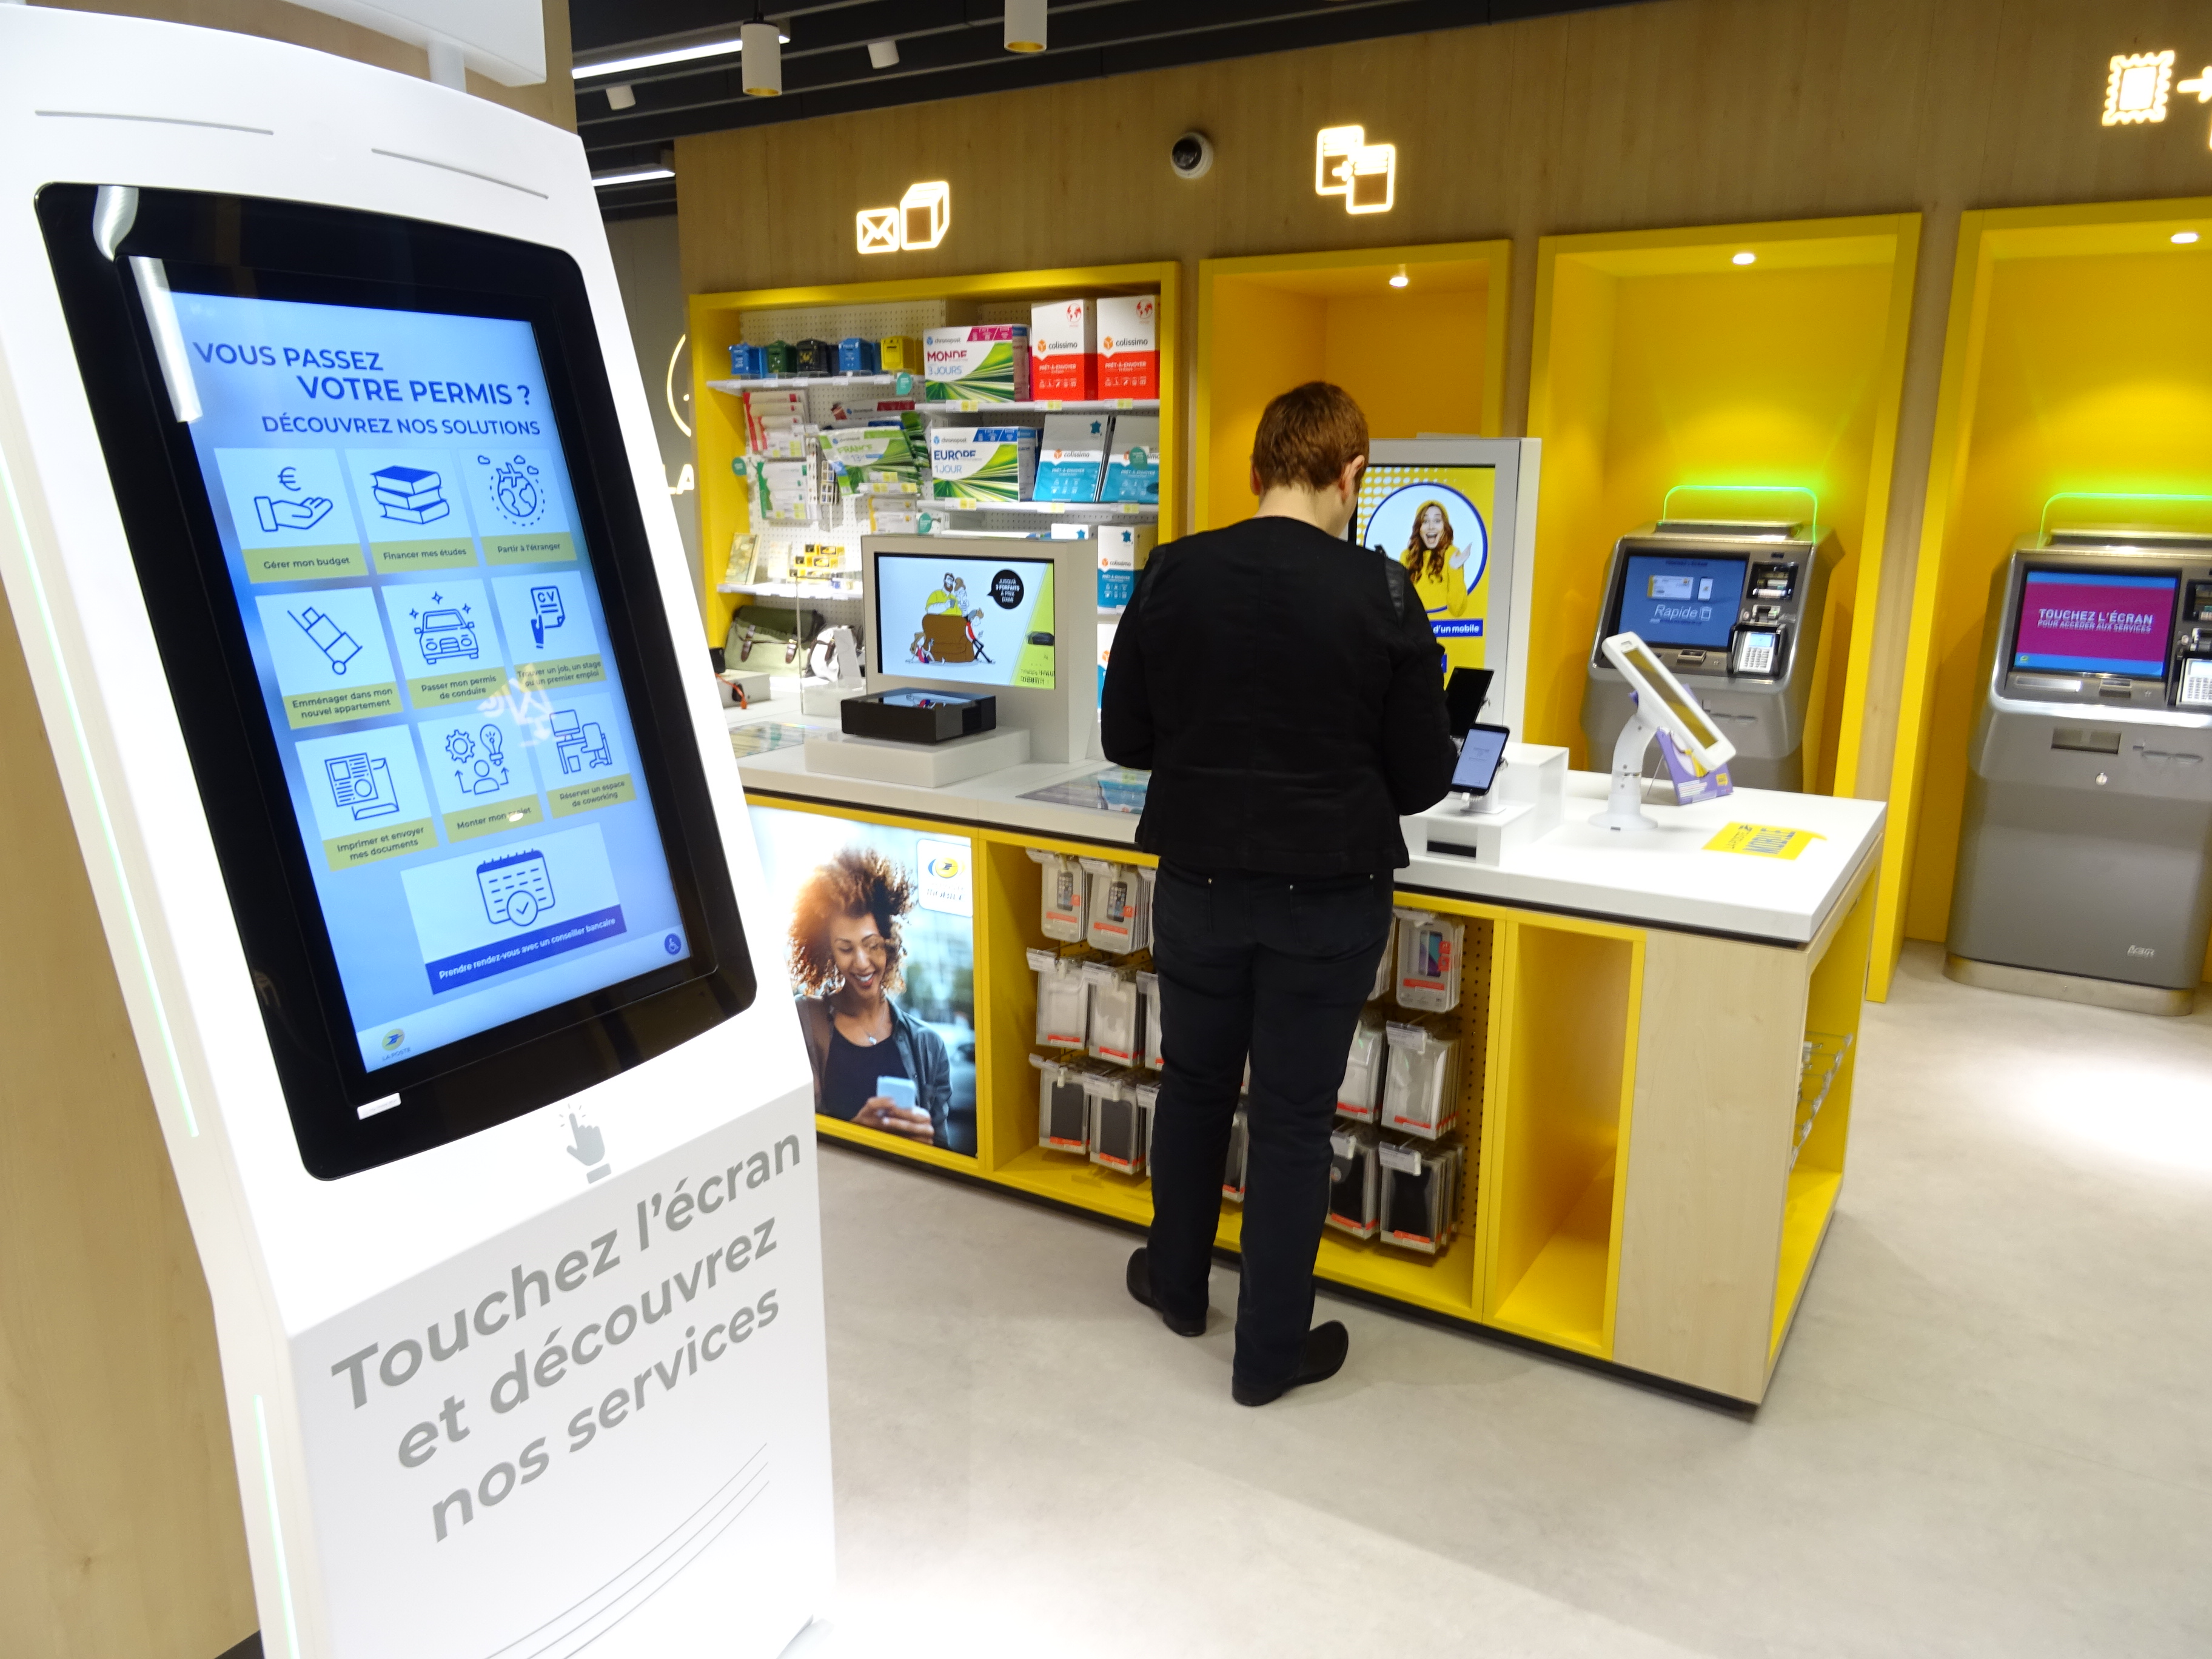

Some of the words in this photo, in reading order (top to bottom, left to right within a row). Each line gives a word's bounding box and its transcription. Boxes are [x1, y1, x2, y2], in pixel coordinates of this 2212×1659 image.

[1048, 340, 1078, 349] colissimo
[1116, 337, 1148, 346] colissimo
[193, 341, 276, 366] VOUS
[283, 347, 384, 371] PASSEZ
[928, 366, 933, 375] 3
[934, 366, 962, 375] JOURS
[297, 375, 403, 401] VOTRE
[409, 381, 513, 405] PERMIS
[517, 384, 531, 405] ?
[262, 412, 392, 433] DÉCOUVREZ
[398, 419, 438, 435] NOS
[442, 420, 541, 436] SOLUTIONS
[934, 449, 976, 461] EUROPE
[940, 464, 962, 474] JOUR
[383, 551, 419, 560] Financer
[440, 548, 467, 557] études
[497, 545, 518, 554] Partir
[526, 542, 561, 553] l'étranger
[263, 559, 290, 569] Gérer
[293, 559, 314, 568] mon
[317, 556, 350, 568] budget
[1654, 604, 1698, 621] Rapide
[2039, 608, 2096, 622] TOUCHEZ
[2098, 609, 2153, 625] L'ÉCRAN
[1433, 625, 1451, 634] d'un
[1452, 624, 1480, 634] mobile
[2037, 619, 2059, 628] POUR
[2113, 624, 2151, 634] SERVICES
[558, 664, 571, 675] job,
[582, 660, 602, 671] stage
[421, 682, 448, 693] Passer
[449, 680, 469, 688] mon
[470, 675, 497, 687] permis
[525, 680, 534, 688] ou
[535, 678, 546, 686] un
[547, 673, 574, 685] premier
[574, 670, 600, 681] emploi
[292, 694, 348, 709] Emménager
[350, 691, 372, 700] dans
[373, 688, 394, 697] mon
[440, 691, 450, 699] de
[451, 686, 487, 697] conduire
[301, 706, 332, 719] nouvel
[334, 699, 392, 716] appartement
[560, 788, 591, 800] Réserver
[602, 780, 626, 793] espace
[572, 799, 581, 807] de
[582, 792, 619, 806] coworking
[457, 817, 486, 831] Monter
[488, 813, 507, 823] mon
[337, 836, 379, 853] Imprimer
[380, 833, 390, 843] et
[391, 827, 424, 842] envoyer
[349, 850, 369, 862] mes
[370, 839, 419, 856] documents
[438, 962, 472, 980] Prendre
[474, 948, 521, 969] rendez-vous
[521, 942, 540, 954] avec
[540, 937, 551, 948] un
[551, 928, 585, 944] conseiller
[585, 917, 616, 933] bancaire
[330, 1228, 620, 1409] Touchez
[637, 1134, 800, 1252] l'écran
[398, 1395, 471, 1469] et
[490, 1216, 777, 1414] découvrez
[432, 1436, 549, 1543] nos
[569, 1288, 779, 1453] services
